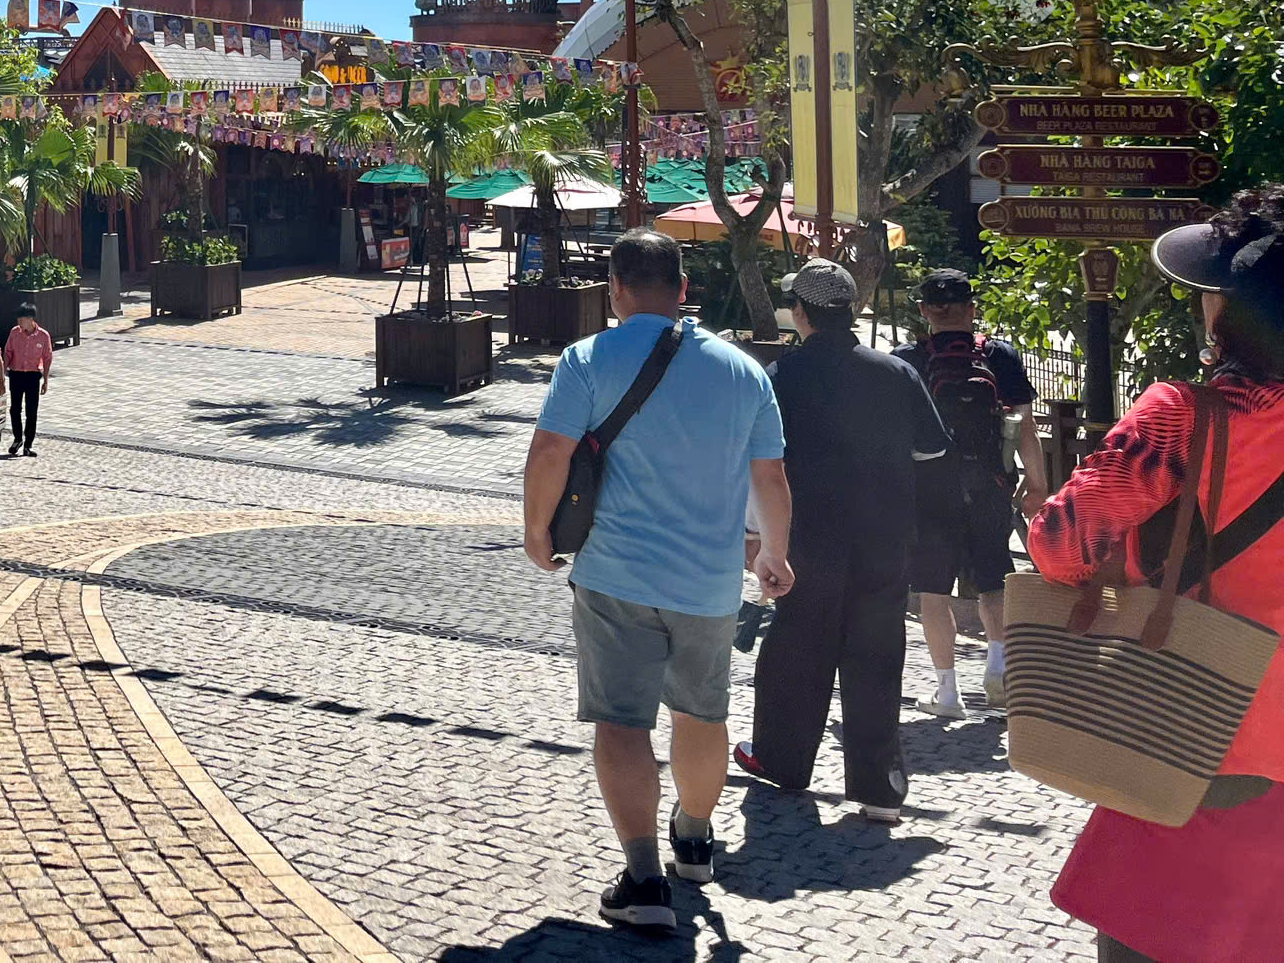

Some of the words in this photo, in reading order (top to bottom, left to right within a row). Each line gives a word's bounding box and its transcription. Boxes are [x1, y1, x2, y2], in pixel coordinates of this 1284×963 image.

[1020, 101, 1048, 117] NHÀ
[1052, 100, 1090, 117] HÀNG
[1094, 104, 1127, 117] BEER
[1131, 105, 1174, 118] PLAZA
[1036, 120, 1061, 130] BEER
[1065, 121, 1093, 131] PLAZA
[1095, 121, 1157, 131] RESTAURANT
[1039, 152, 1069, 169] NHÀ
[1073, 152, 1111, 169] HÀNG
[1116, 155, 1156, 169] TAIGA
[1052, 172, 1081, 181] TAIGA
[1083, 172, 1145, 182] RESTAURANT
[1060, 206, 1081, 219] BIA
[1112, 204, 1146, 220] CÔNG
